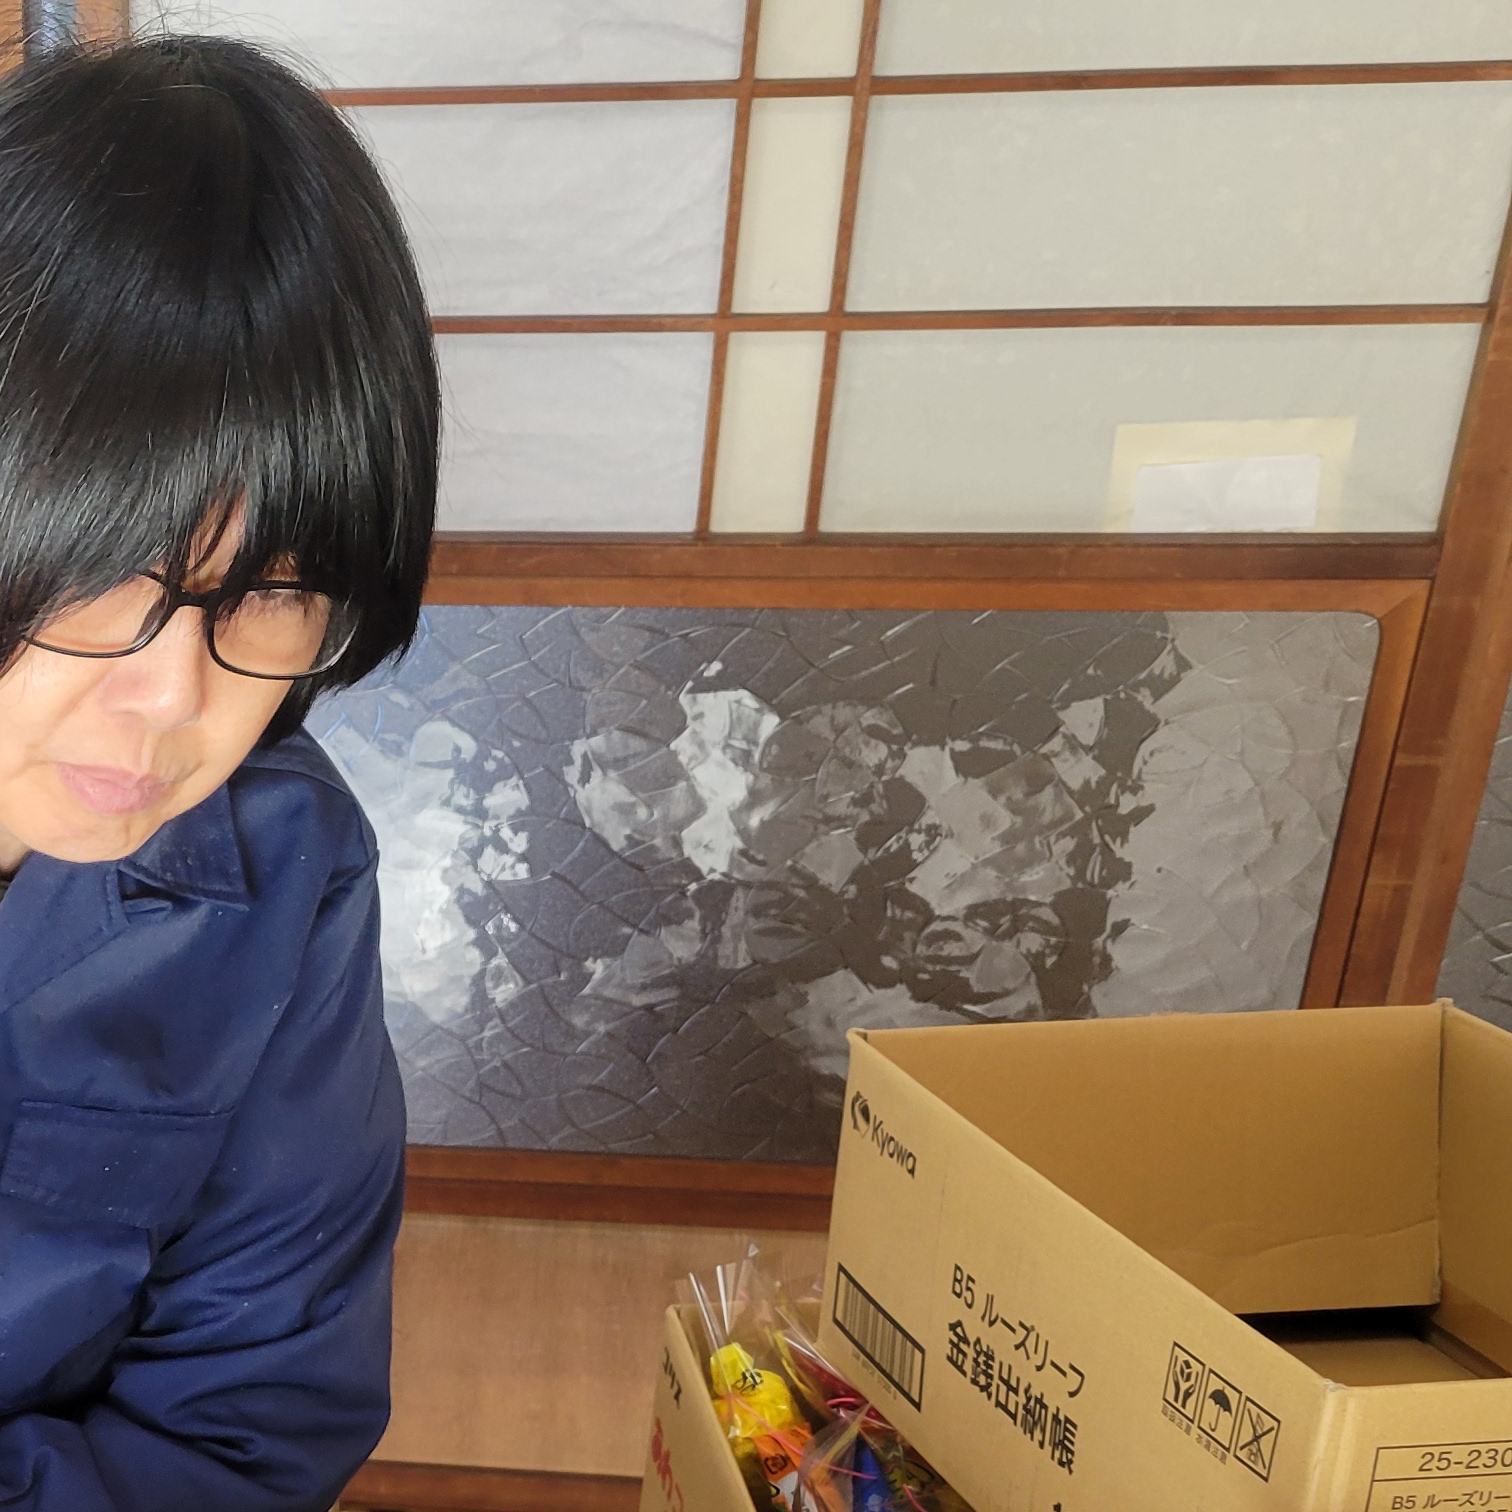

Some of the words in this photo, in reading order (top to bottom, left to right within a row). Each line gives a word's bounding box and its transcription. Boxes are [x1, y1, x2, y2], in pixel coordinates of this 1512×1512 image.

[872, 1114, 917, 1179] Kyowa
[951, 1263, 976, 1309] B5
[981, 1293, 1085, 1398] ルーズリーフ
[946, 1319, 1078, 1475] 金銭出納帳
[1391, 1495, 1417, 1510] B5
